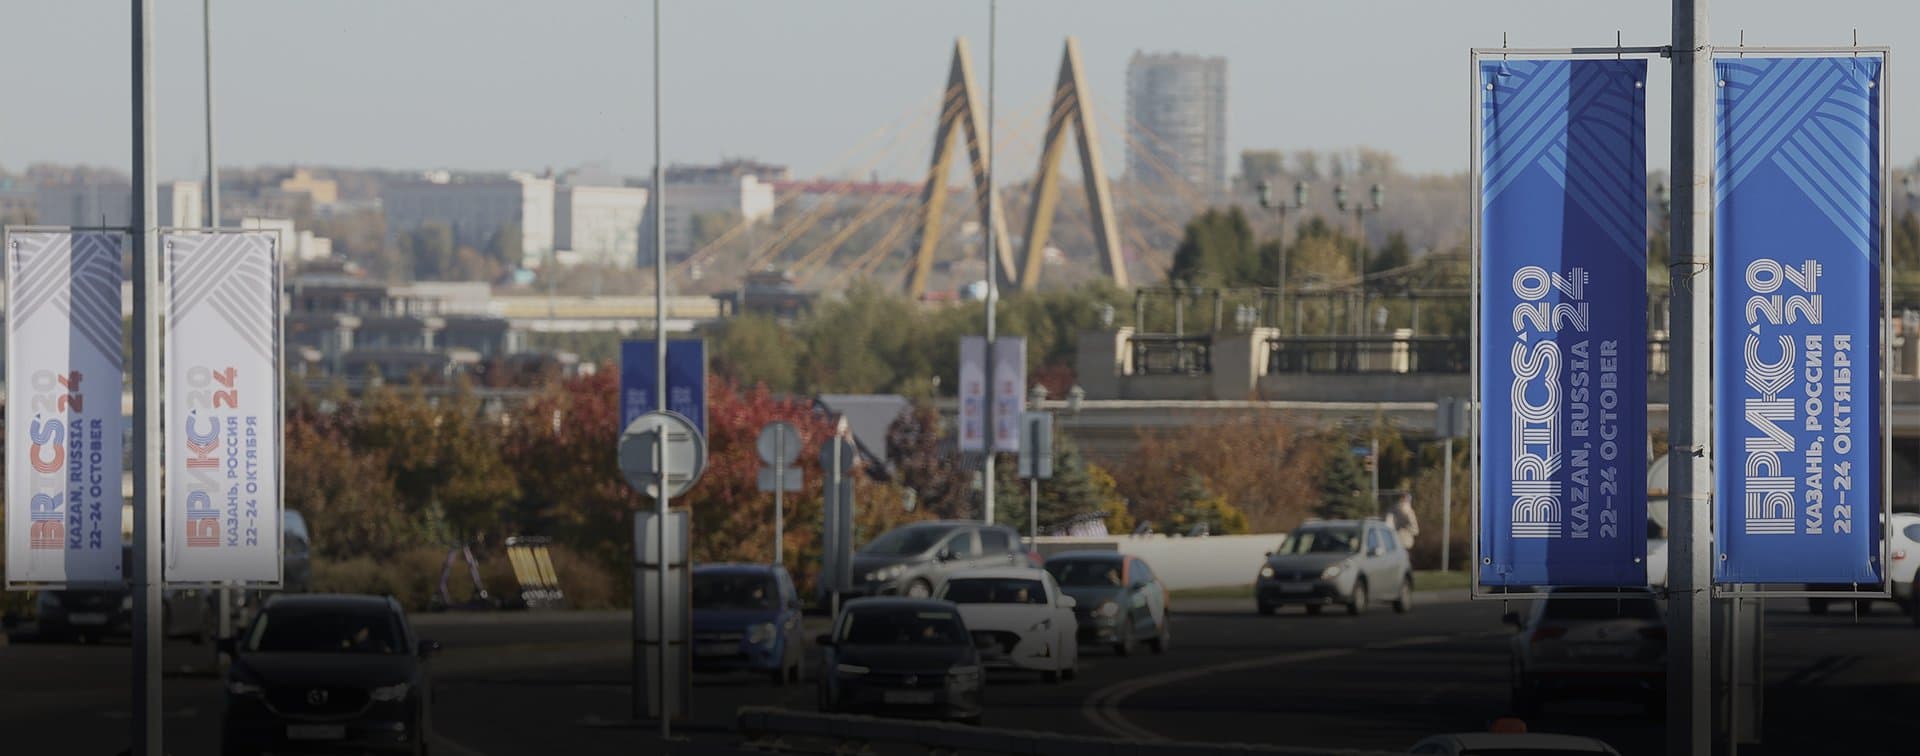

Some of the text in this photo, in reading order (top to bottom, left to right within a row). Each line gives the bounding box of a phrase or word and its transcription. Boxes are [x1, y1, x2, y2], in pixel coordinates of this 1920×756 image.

[90, 418, 102, 497] OCTOBER
[246, 416, 258, 494] ОКТЯБРЯ
[1511, 338, 1563, 539] BRICS
[1571, 340, 1592, 539] KAZAN, RUSSIA
[1600, 340, 1618, 462] OCTOBER
[1744, 334, 1796, 535] БРИКС
[1804, 334, 1824, 535] КАЗАНЬ, РОССИЯ
[1834, 334, 1852, 455] ОКТЯБРЯ
[30, 418, 65, 550] BRICS
[70, 418, 84, 550] KAZAN, RUSSIA
[186, 415, 220, 548] БРИКС
[227, 416, 240, 546] КАЗАНЬ, РОССИЯ
